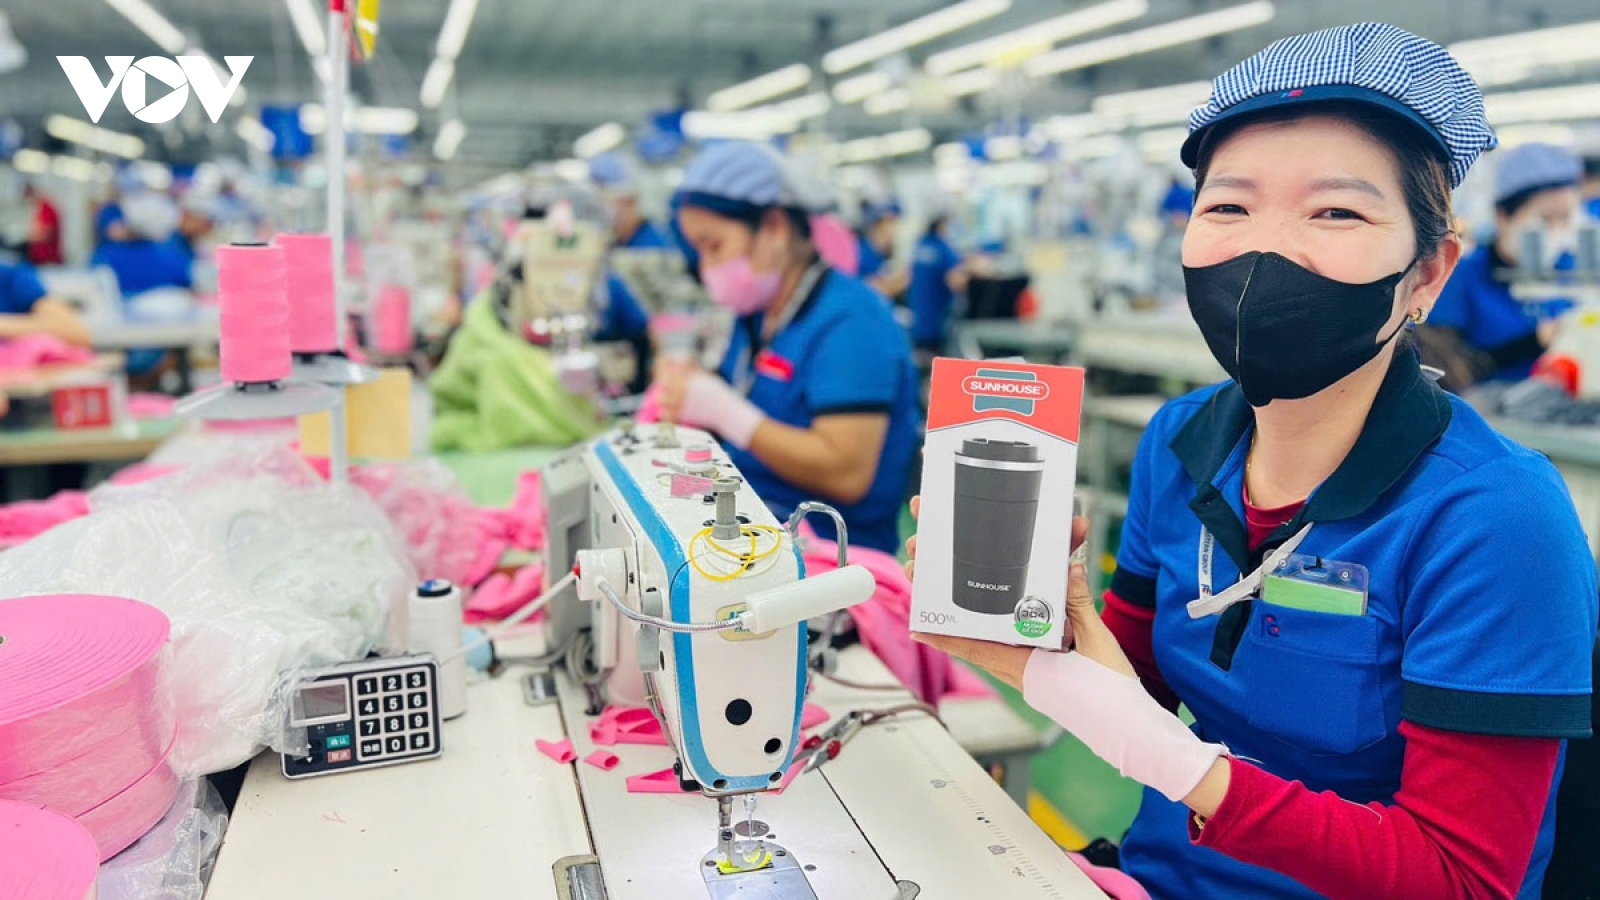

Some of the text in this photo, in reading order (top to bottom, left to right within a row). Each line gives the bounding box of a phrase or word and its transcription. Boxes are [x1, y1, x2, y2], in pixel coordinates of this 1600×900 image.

[970, 381, 1041, 395] SUNHOUSE
[967, 580, 1010, 592] SUNHOUSE
[365, 674, 421, 693] 1 2 3
[364, 695, 422, 713] 4 5 6
[366, 715, 423, 734] 7 8 9
